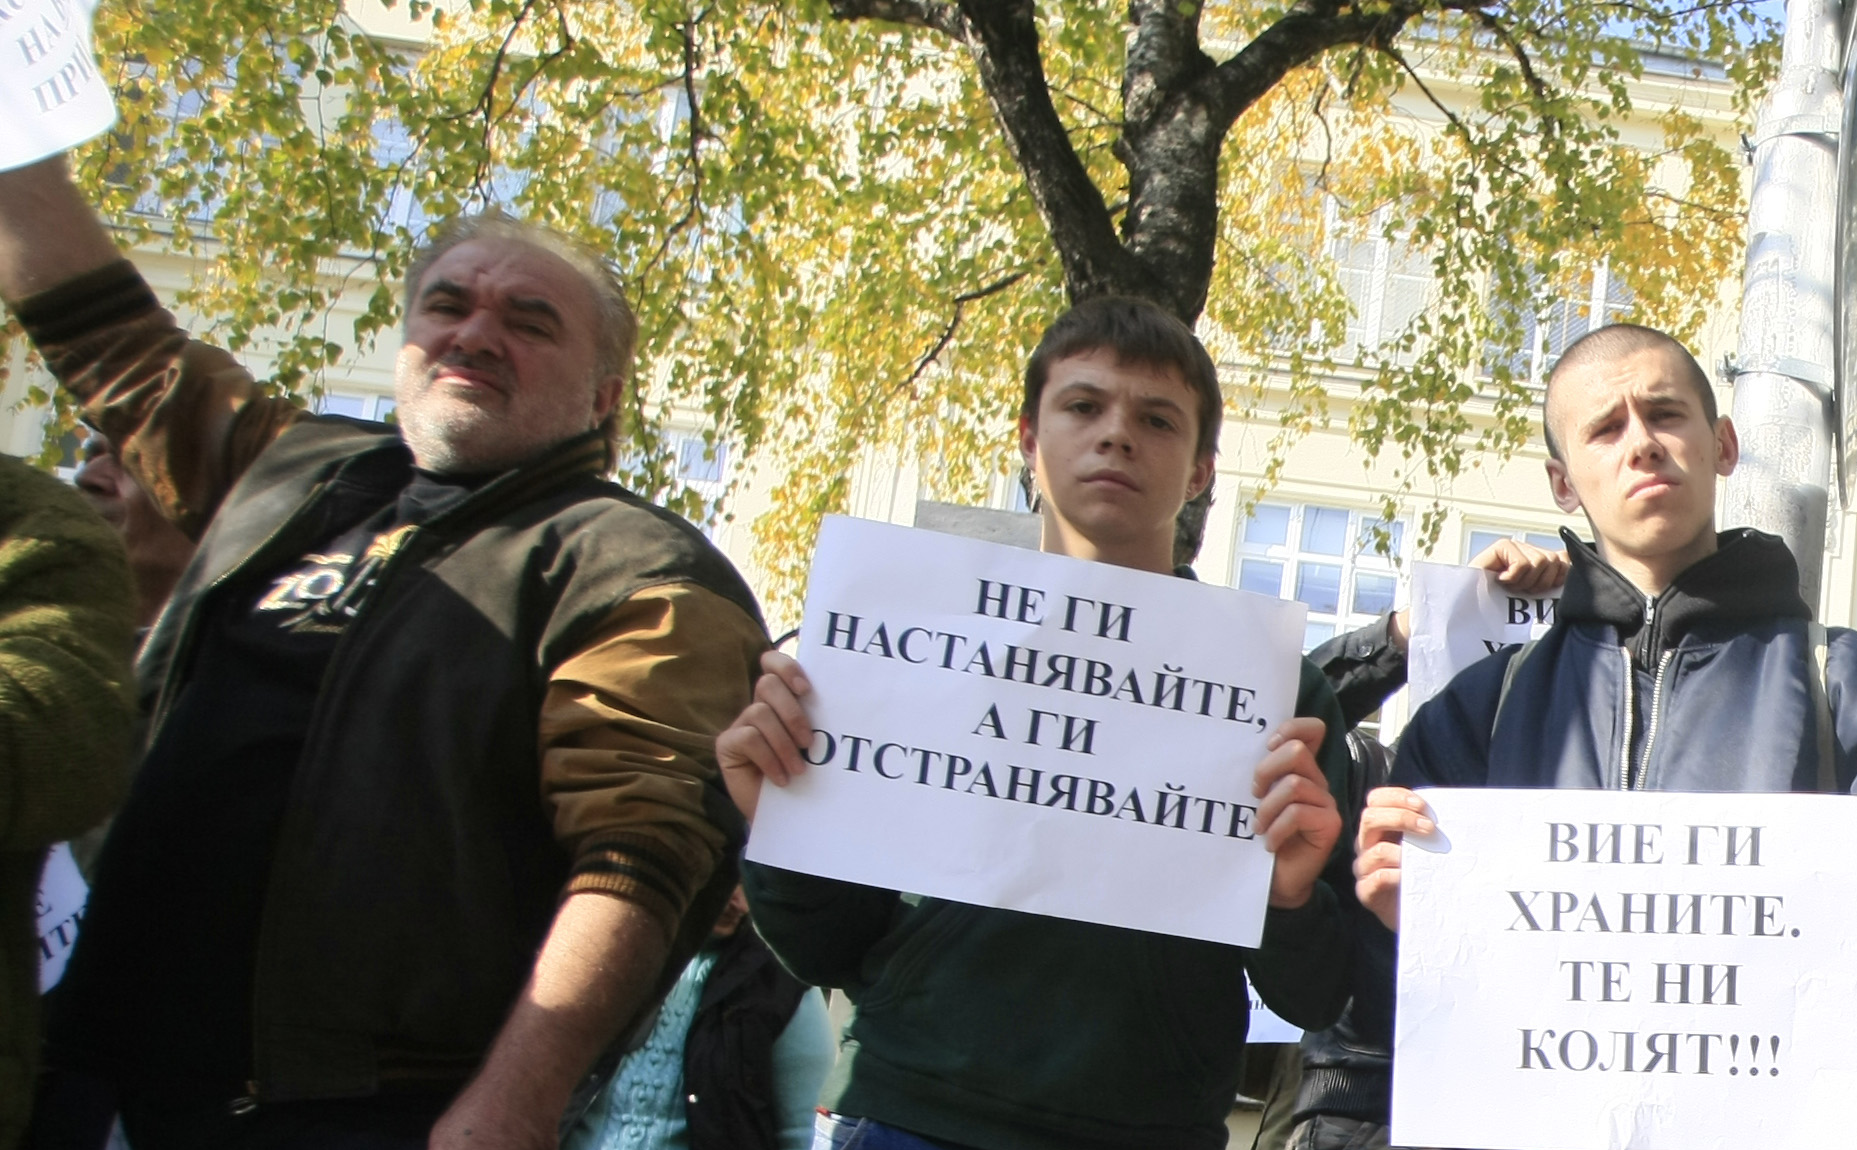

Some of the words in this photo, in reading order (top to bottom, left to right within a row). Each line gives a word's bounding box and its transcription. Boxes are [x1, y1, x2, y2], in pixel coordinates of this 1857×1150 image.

[973, 578, 1046, 626] НЕ
[1060, 595, 1137, 642] ГИ
[822, 610, 1267, 734] НАСТАНЯВАЙТЕ,
[971, 702, 1007, 740] А
[1024, 708, 1101, 755] ГИ
[803, 729, 1257, 841] ОТСТРАНЯВАЙТЕ
[1544, 822, 1664, 864] ВИЕ
[1682, 824, 1767, 866] ГИ
[1504, 890, 1800, 937] ХРАНИТЕ.
[1559, 960, 1632, 1002] ТЕ
[1650, 962, 1743, 1005] НИ
[1516, 1028, 1780, 1076] КОЛЯТ!!!
